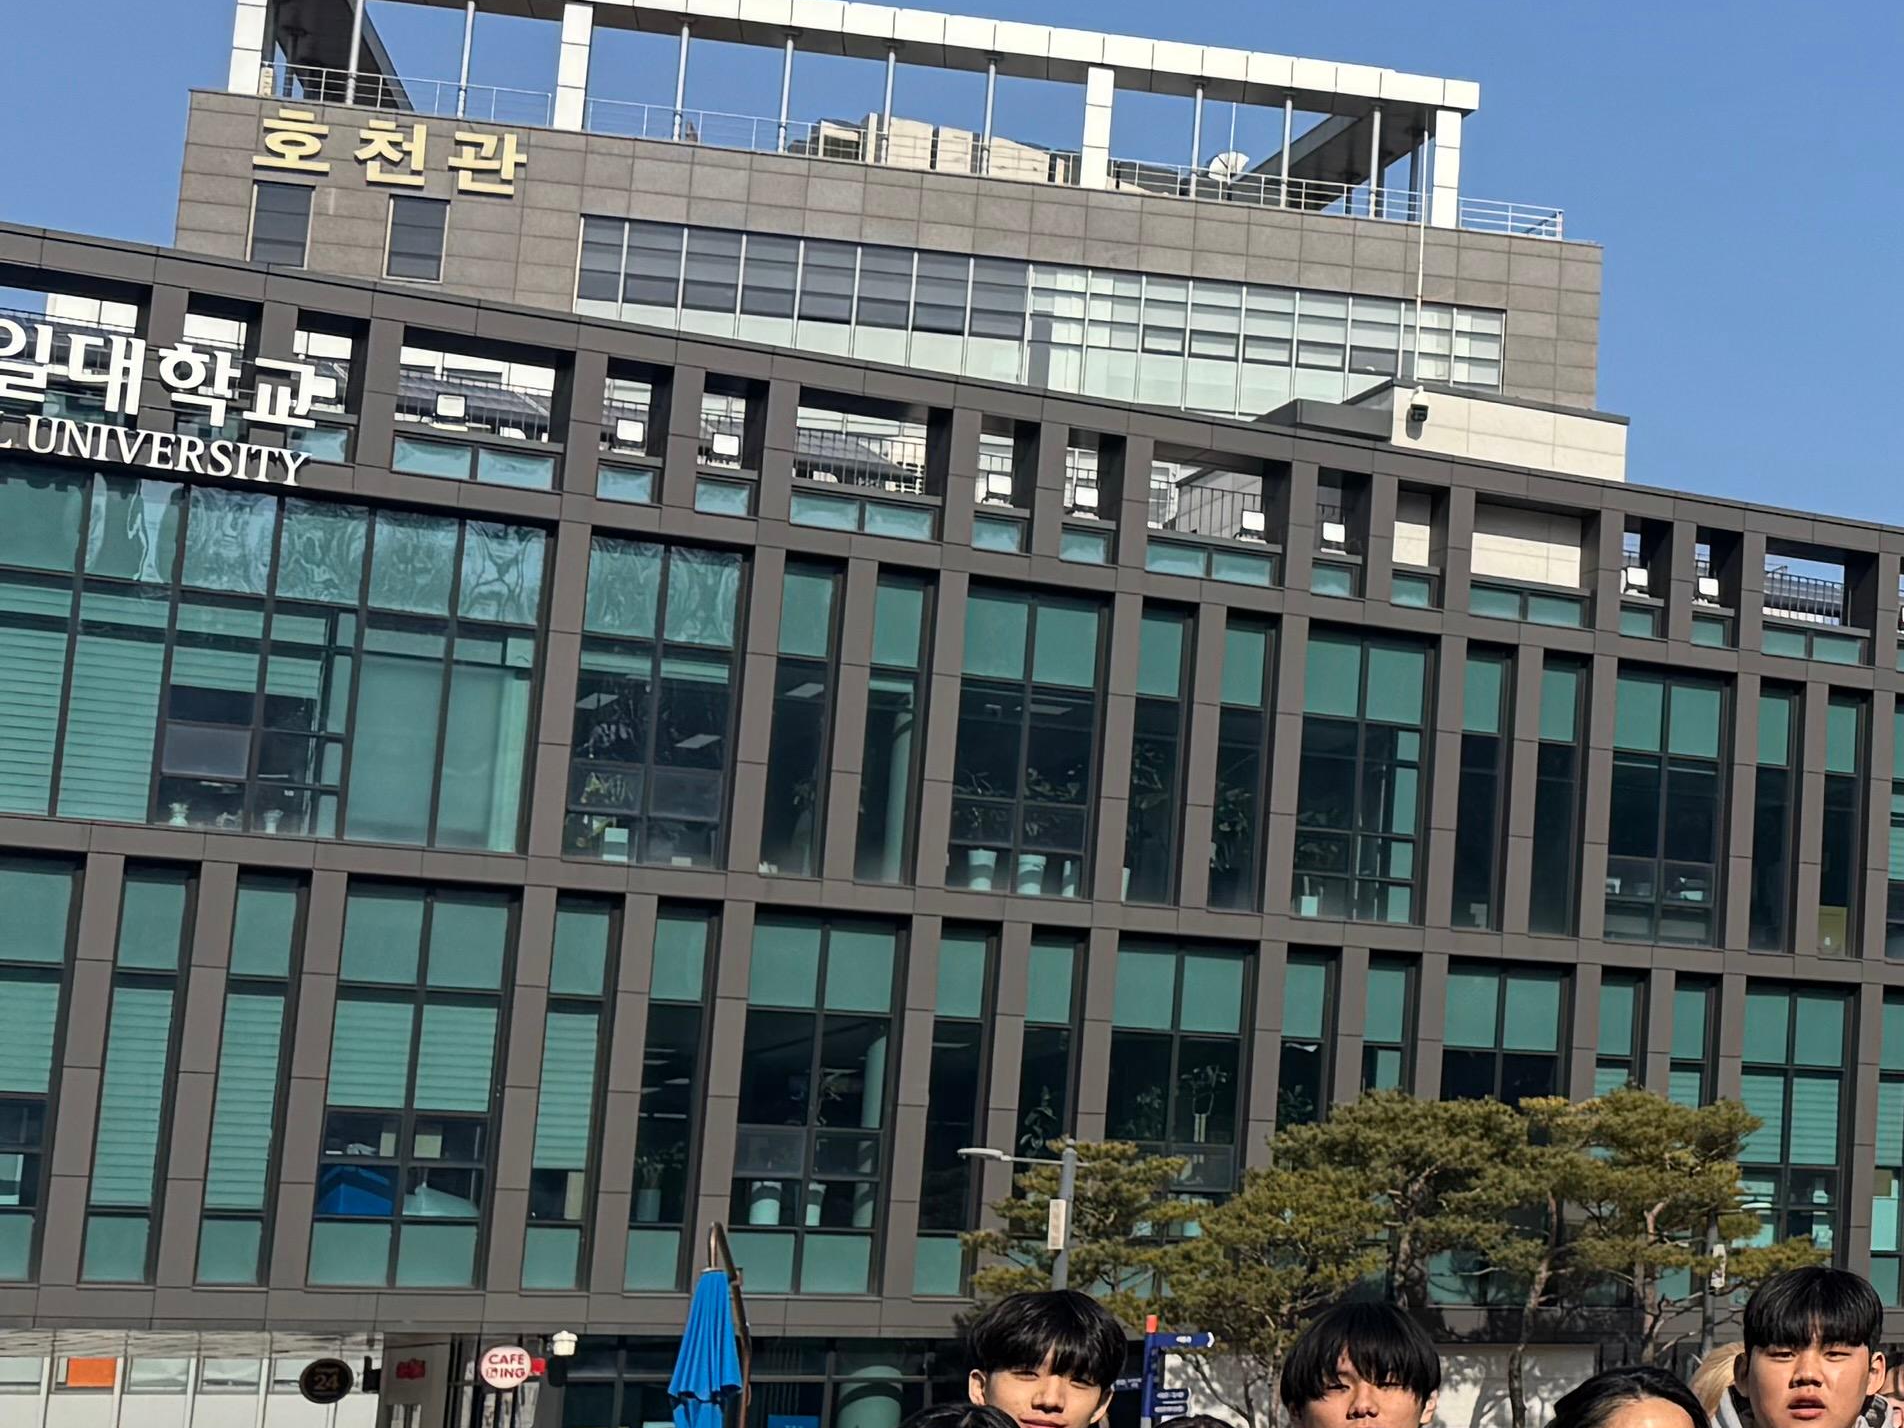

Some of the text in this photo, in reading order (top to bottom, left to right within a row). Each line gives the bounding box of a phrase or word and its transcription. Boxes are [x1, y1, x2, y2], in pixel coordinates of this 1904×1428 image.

[252, 108, 528, 196] 호천관
[25, 414, 312, 486] UNIVERSITY
[488, 1353, 525, 1365] CAFE
[313, 1374, 340, 1390] 24
